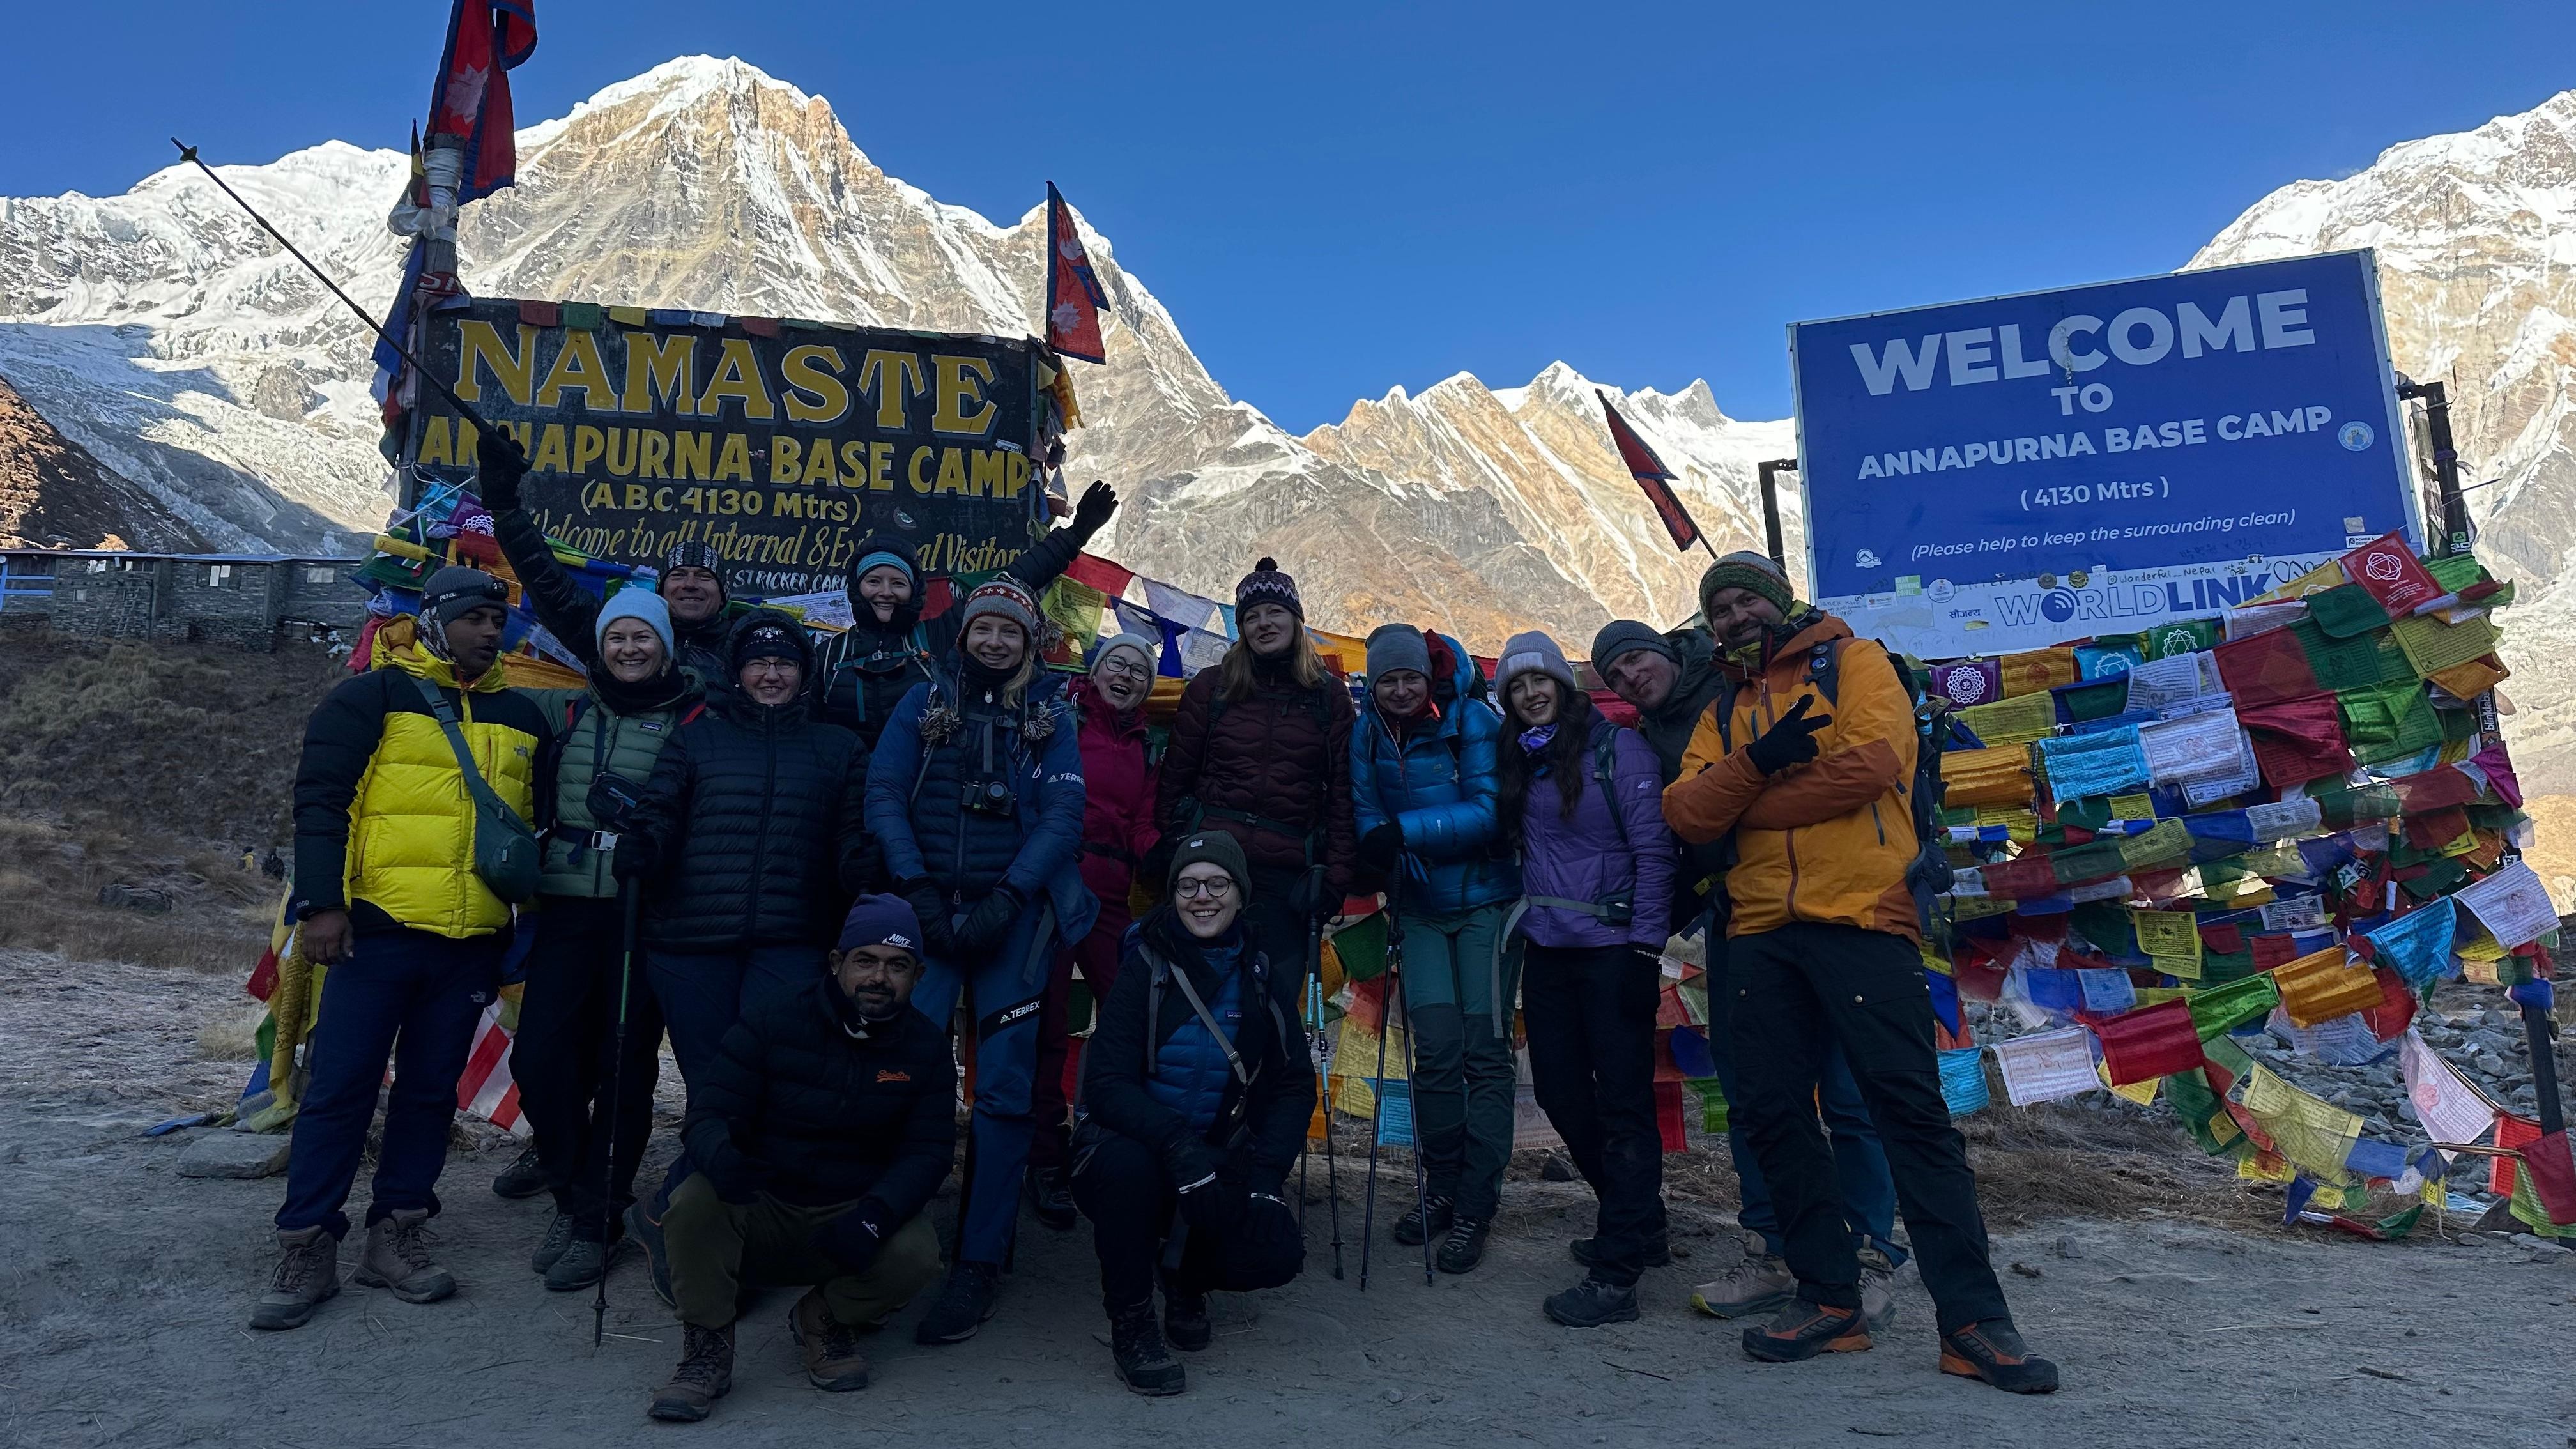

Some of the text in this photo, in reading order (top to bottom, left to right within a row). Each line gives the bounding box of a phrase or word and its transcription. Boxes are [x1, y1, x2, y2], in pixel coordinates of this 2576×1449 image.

[1849, 288, 2316, 396] WELCOME
[453, 319, 999, 435] NAMASTE
[2051, 383, 2113, 415] TO
[770, 435, 894, 491] BASE
[908, 445, 1031, 499] CAMP
[1857, 431, 2097, 480] ANNAPURNA
[2104, 418, 2207, 453] BASE
[2216, 405, 2332, 441] CAMP
[772, 491, 861, 525] Mtrs)
[1911, 508, 2296, 562] (Please help to keep the surrounding clean)
[629, 517, 655, 558] to
[946, 533, 1029, 573] Visitor
[1994, 573, 2271, 627] WORLDLINK
[1059, 772, 1085, 786] TERRE
[1637, 781, 1652, 790] 4F
[888, 933, 912, 946] NIKE
[1010, 1000, 1041, 1019] TERREX
